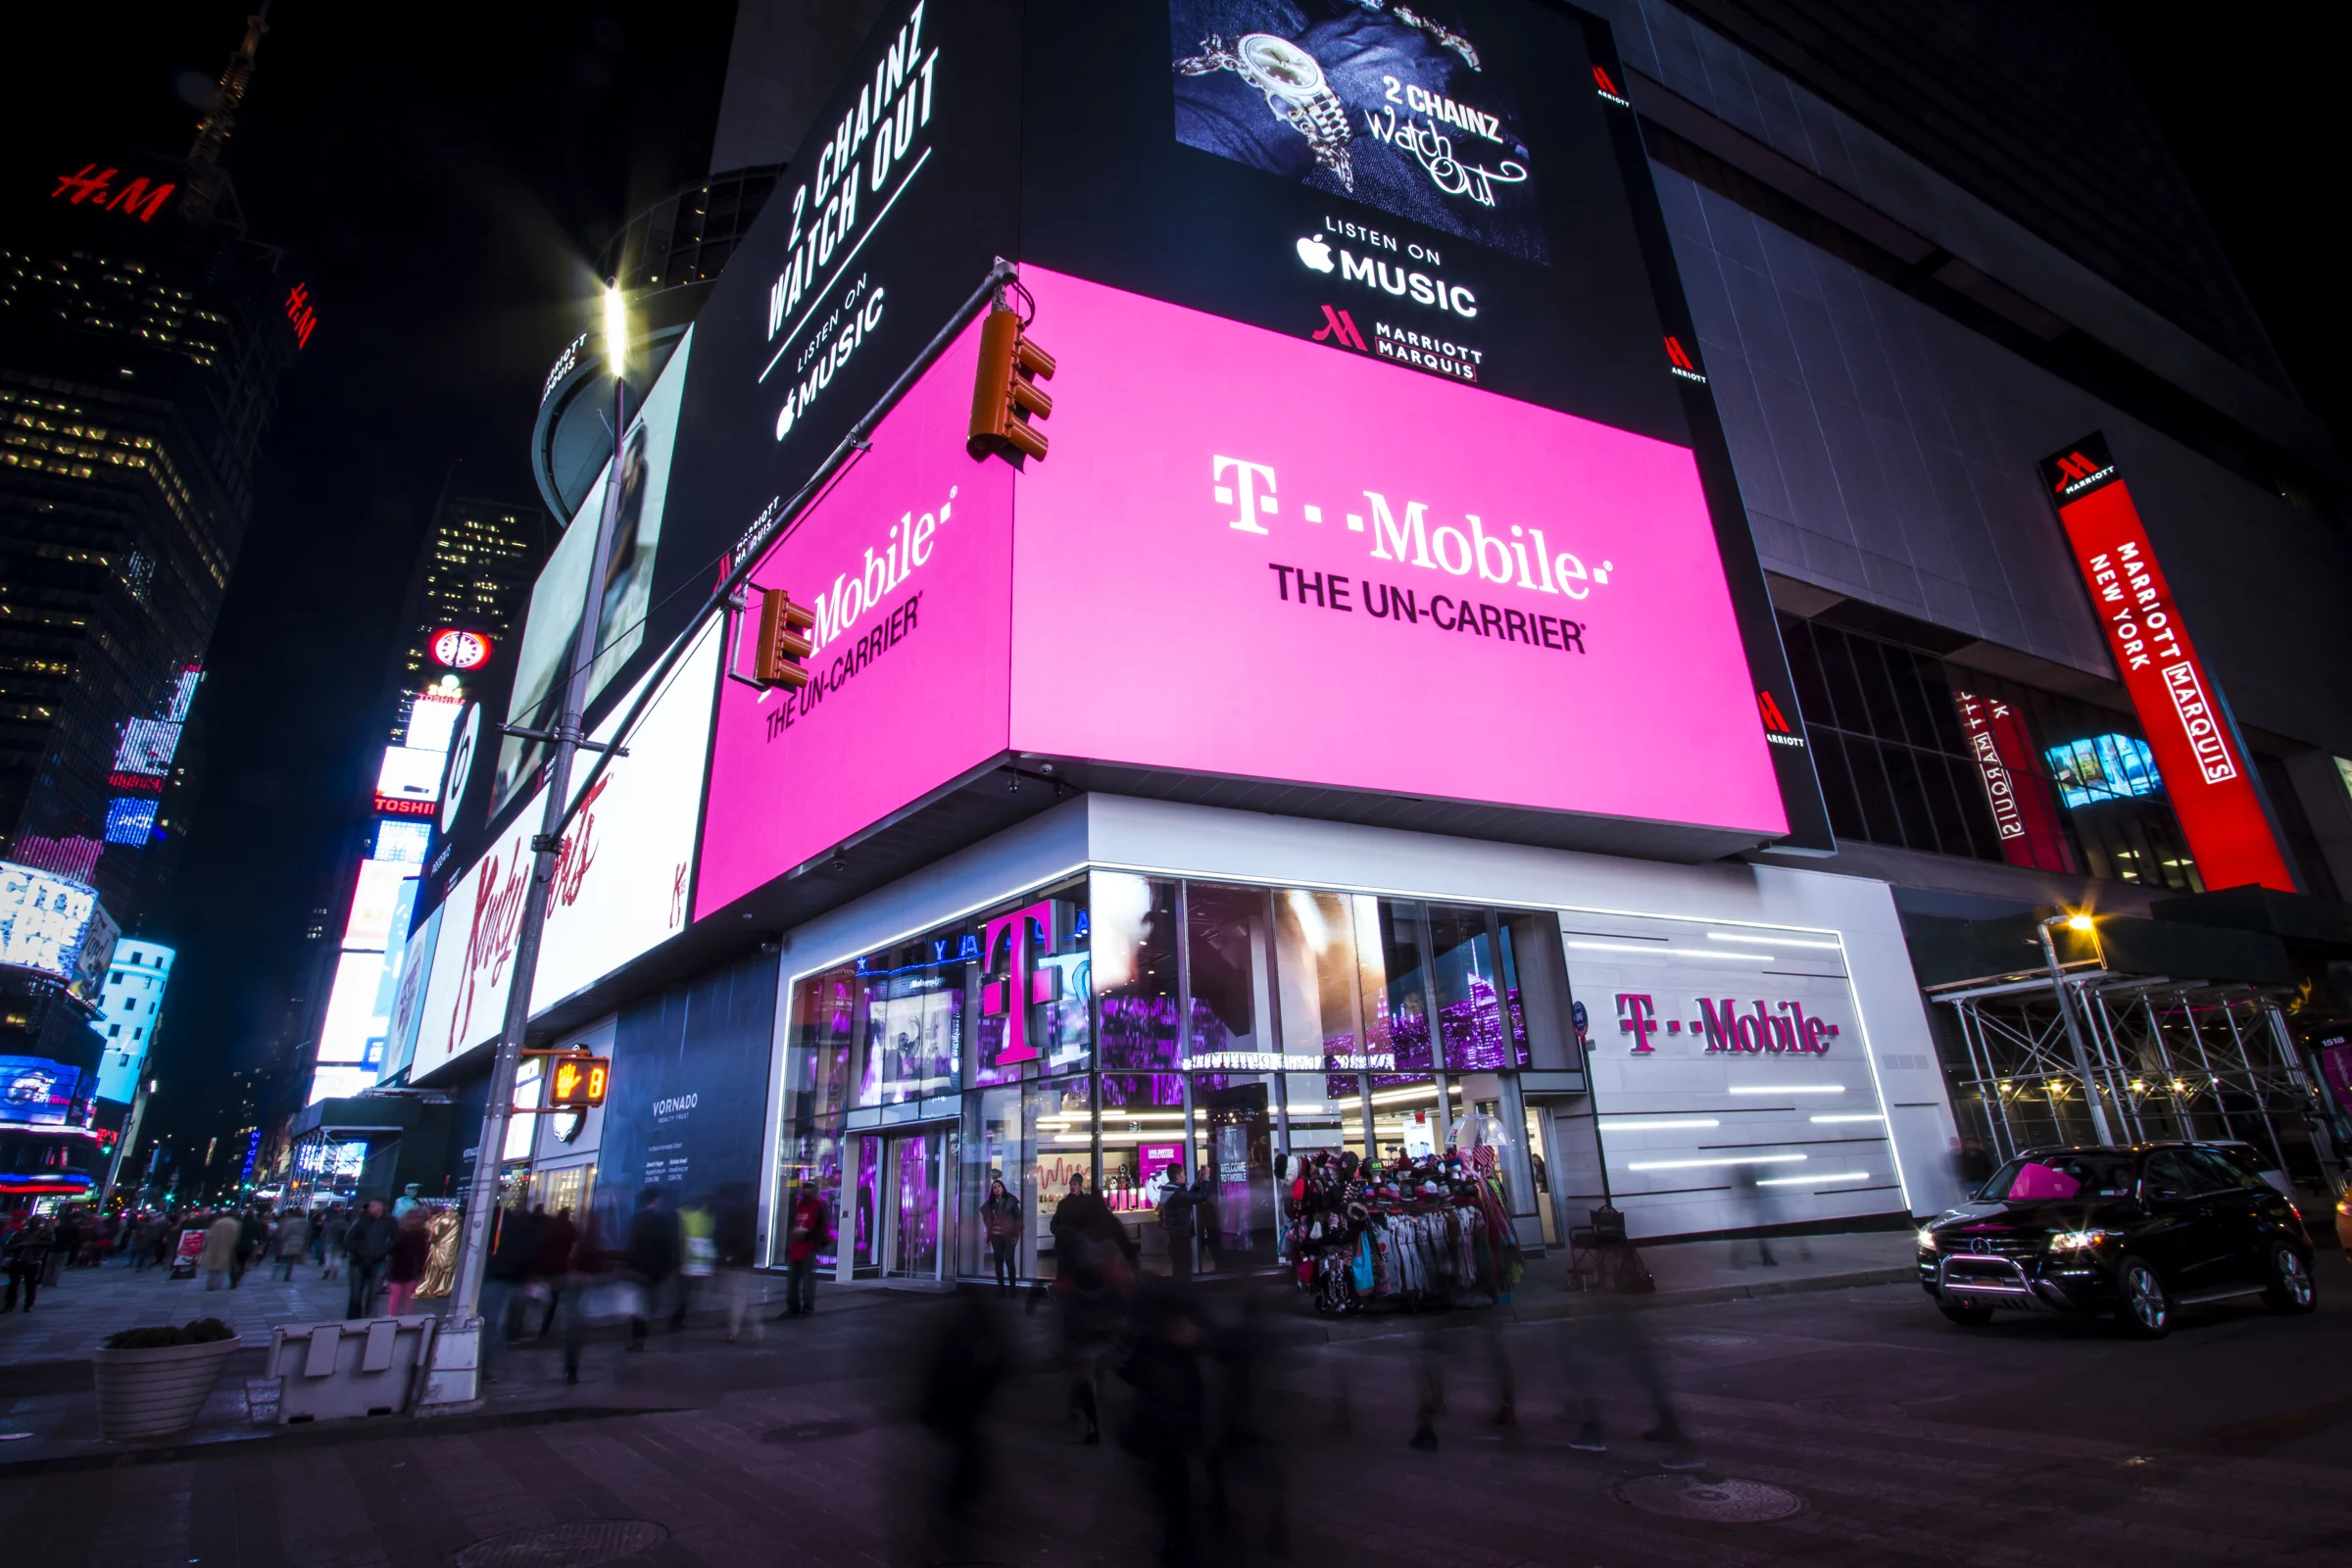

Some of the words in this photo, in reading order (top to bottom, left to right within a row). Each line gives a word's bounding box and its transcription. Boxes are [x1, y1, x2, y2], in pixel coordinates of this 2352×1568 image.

[788, 184, 807, 252] 2
[814, 0, 925, 208] CHAINZ
[1365, 105, 1452, 160] Watch
[1383, 75, 1404, 104] 2
[1406, 86, 1503, 144] CHAINZ
[51, 163, 175, 223] H&M
[768, 162, 860, 342] WATCH
[871, 46, 939, 192] OUT
[1429, 156, 1528, 207] Out
[1326, 217, 1397, 253] LISTEN
[1407, 242, 1441, 267] ON
[1341, 249, 1478, 318] MUSIC
[285, 282, 317, 350] H&M
[797, 314, 839, 372] LISTEN
[845, 271, 867, 310] ON
[1375, 321, 1483, 365] MARRIOTT
[797, 287, 884, 419] MUSIC
[1378, 340, 1475, 380] MARQUIS
[2066, 466, 2115, 495] MARRIOTT
[1268, 563, 1352, 613] THE
[1362, 580, 1587, 655] UN-CARRIER
[2089, 553, 2124, 602] NEW
[2112, 608, 2150, 671] YORK
[765, 695, 796, 743] THE
[800, 596, 919, 716] UN-CARRIER
[2117, 541, 2181, 658] MARRIOTT
[2170, 665, 2231, 782] MARQUIS
[417, 693, 466, 706] TOSHIBA
[589, 1068, 605, 1098] 8
[653, 1093, 698, 1117] VORNADO
[1220, 1161, 1247, 1173] WELCOME
